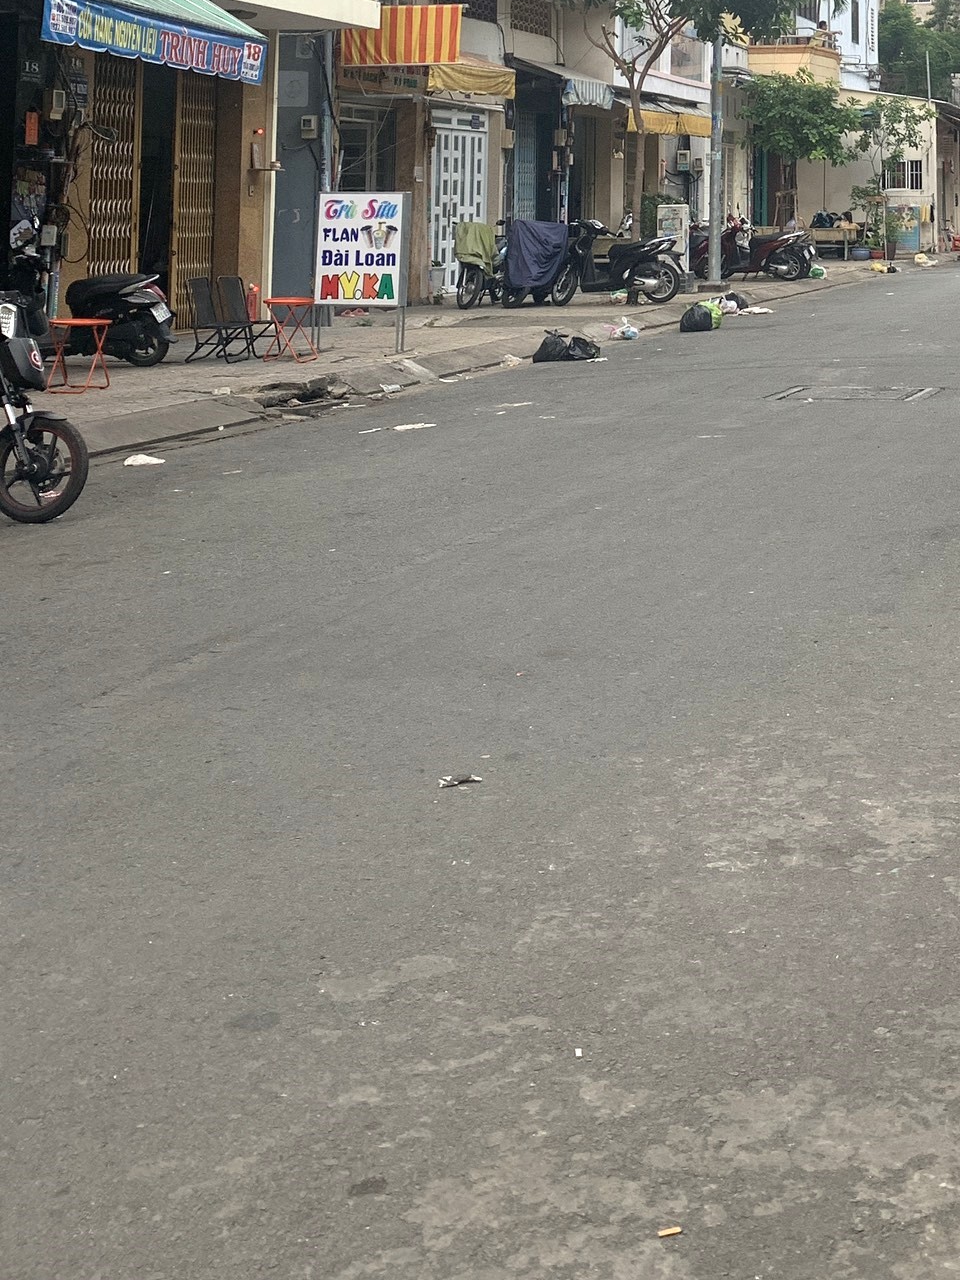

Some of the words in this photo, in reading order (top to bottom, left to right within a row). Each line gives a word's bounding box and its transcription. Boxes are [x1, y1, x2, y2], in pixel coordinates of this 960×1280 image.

[114, 17, 142, 51] NGUYÊN
[160, 26, 209, 69] TRÌNH
[210, 41, 242, 75] HUY
[246, 43, 261, 61] 18
[24, 61, 39, 73] 18
[325, 199, 357, 220] Trà
[361, 199, 398, 220] Sữa
[323, 228, 359, 242] FLAN
[321, 249, 349, 266] Đài
[355, 250, 396, 266] Loan
[320, 270, 395, 300] MY.KA
